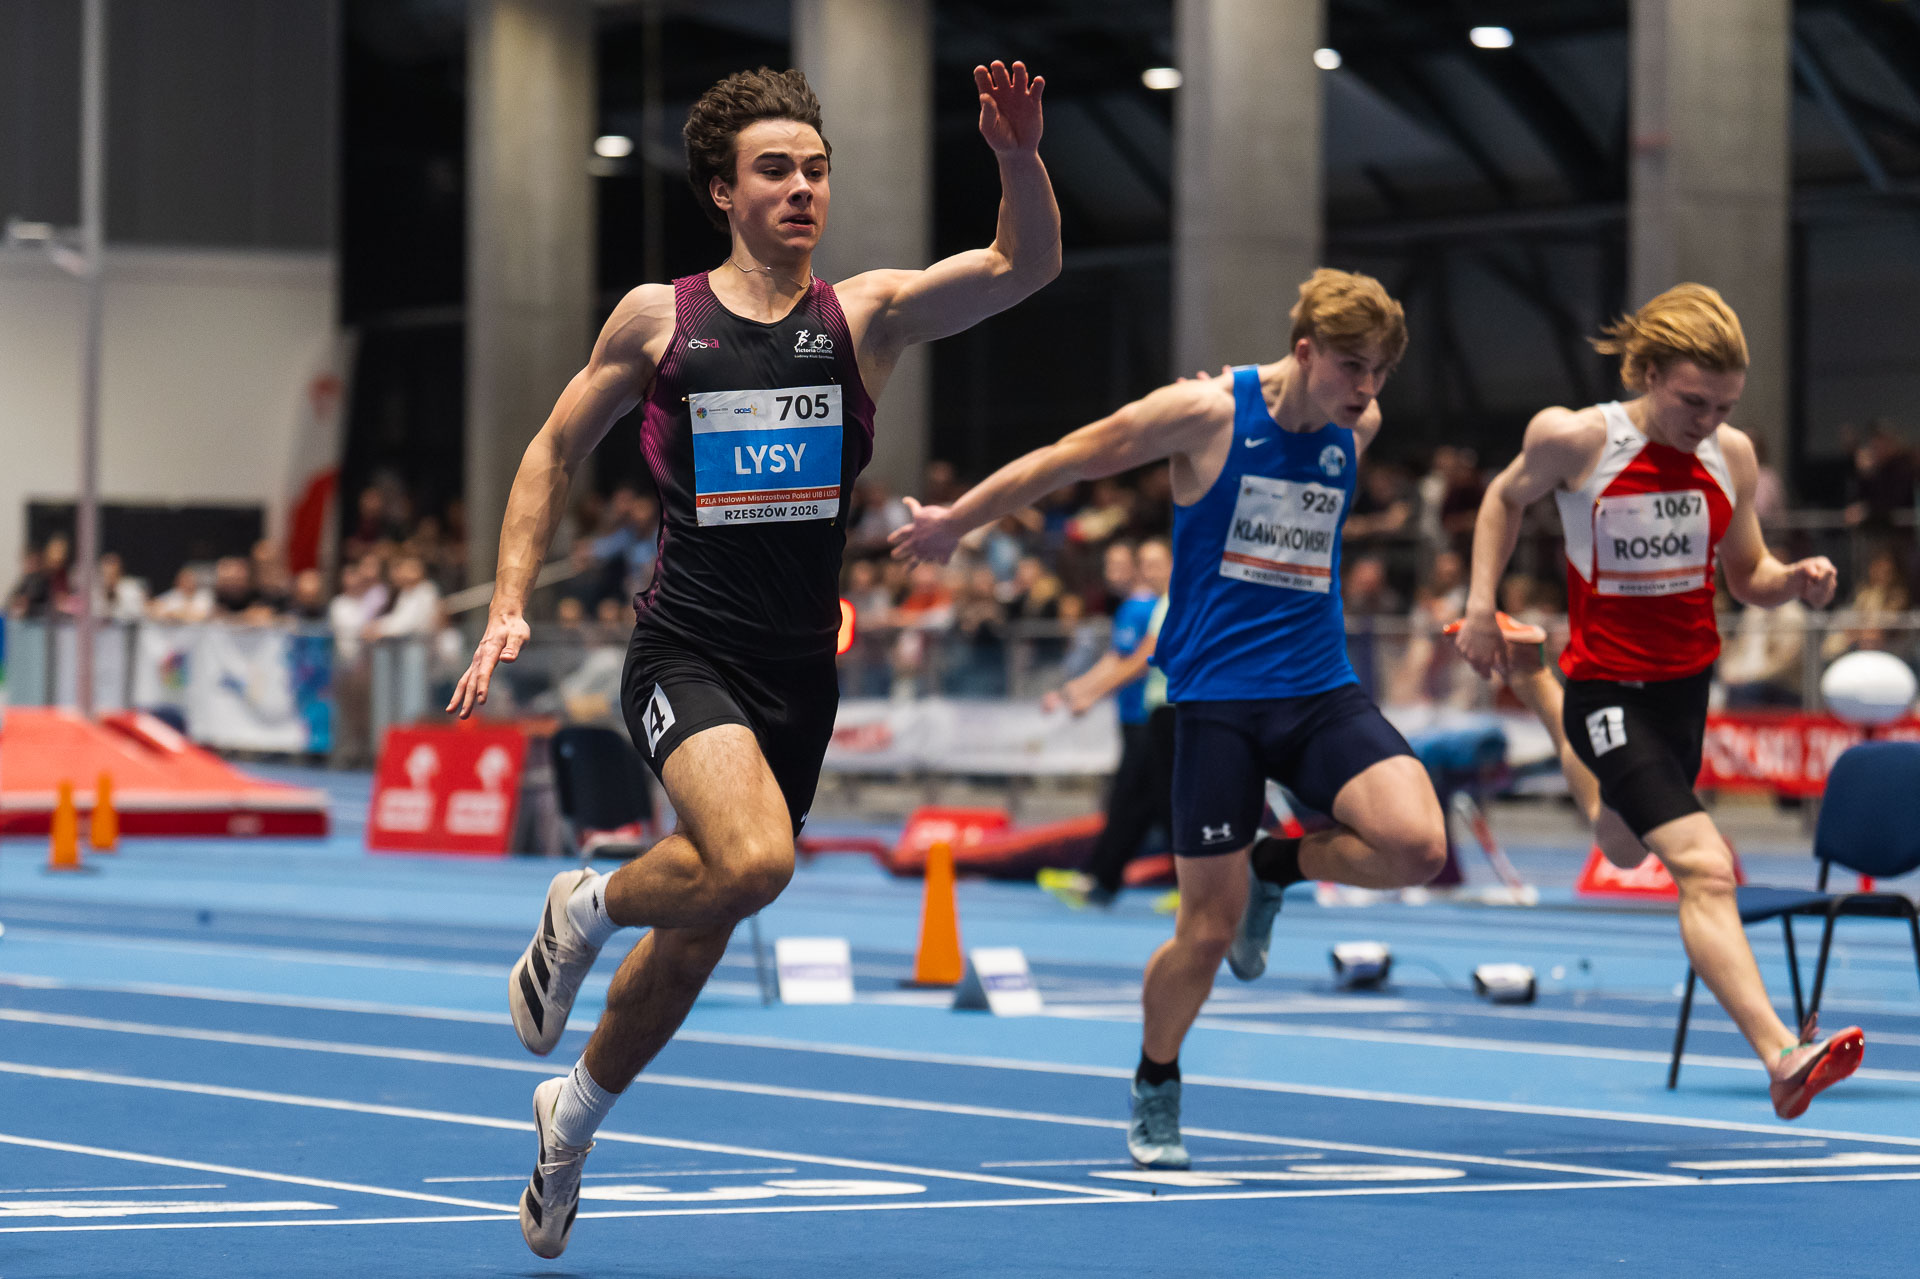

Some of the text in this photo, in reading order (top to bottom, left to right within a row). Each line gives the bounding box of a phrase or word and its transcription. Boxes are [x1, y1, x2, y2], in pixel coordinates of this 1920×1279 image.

[776, 394, 830, 421] 705
[734, 443, 807, 475] LYSY
[700, 497, 717, 505] PZLA
[718, 495, 747, 504] Halowe
[747, 493, 791, 502] Mistrzostwa
[791, 491, 811, 500] Polski
[826, 489, 838, 497] U20
[1302, 490, 1337, 514] 926
[1654, 496, 1702, 519] 1067
[724, 504, 819, 520] RZESZÓW 2026
[1613, 530, 1693, 560] ROSÓŁ
[649, 696, 666, 740] 4
